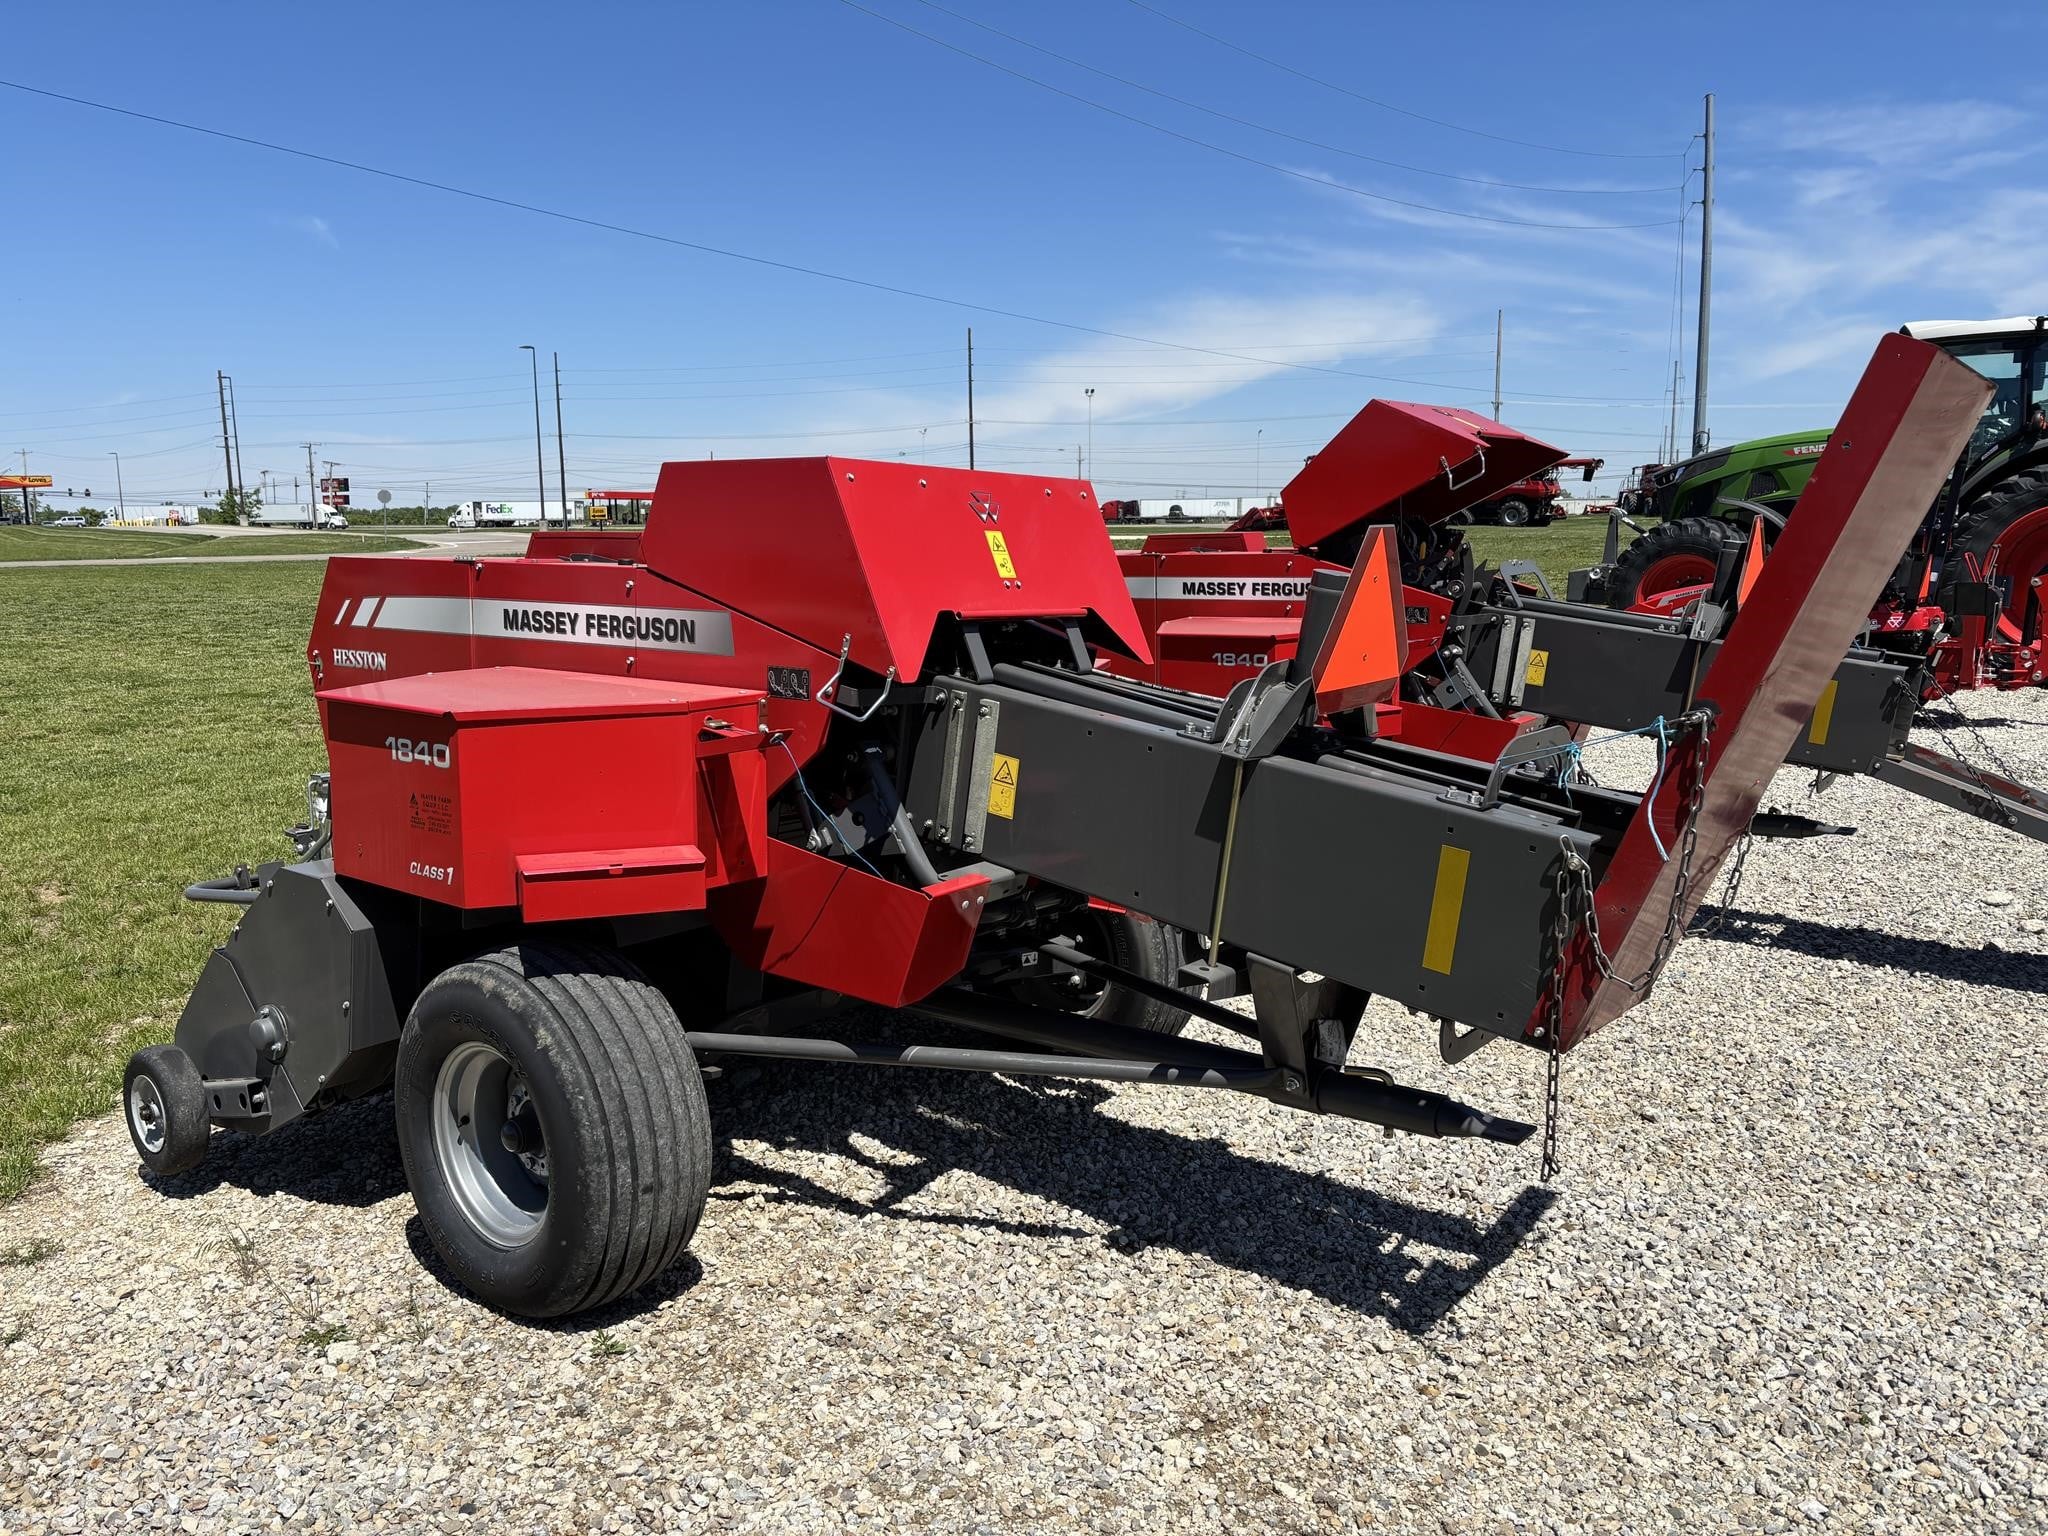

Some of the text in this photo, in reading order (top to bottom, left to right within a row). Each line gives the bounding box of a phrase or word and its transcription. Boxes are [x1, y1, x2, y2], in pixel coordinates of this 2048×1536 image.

[485, 503, 513, 514] FedEx
[1182, 582, 1246, 596] MASSEY
[503, 607, 696, 644] MASSEY FERGUSON
[332, 648, 387, 672] HESSTON
[1212, 653, 1268, 667] 1840
[385, 736, 451, 769] 1840
[410, 861, 454, 885] CLASS 1
